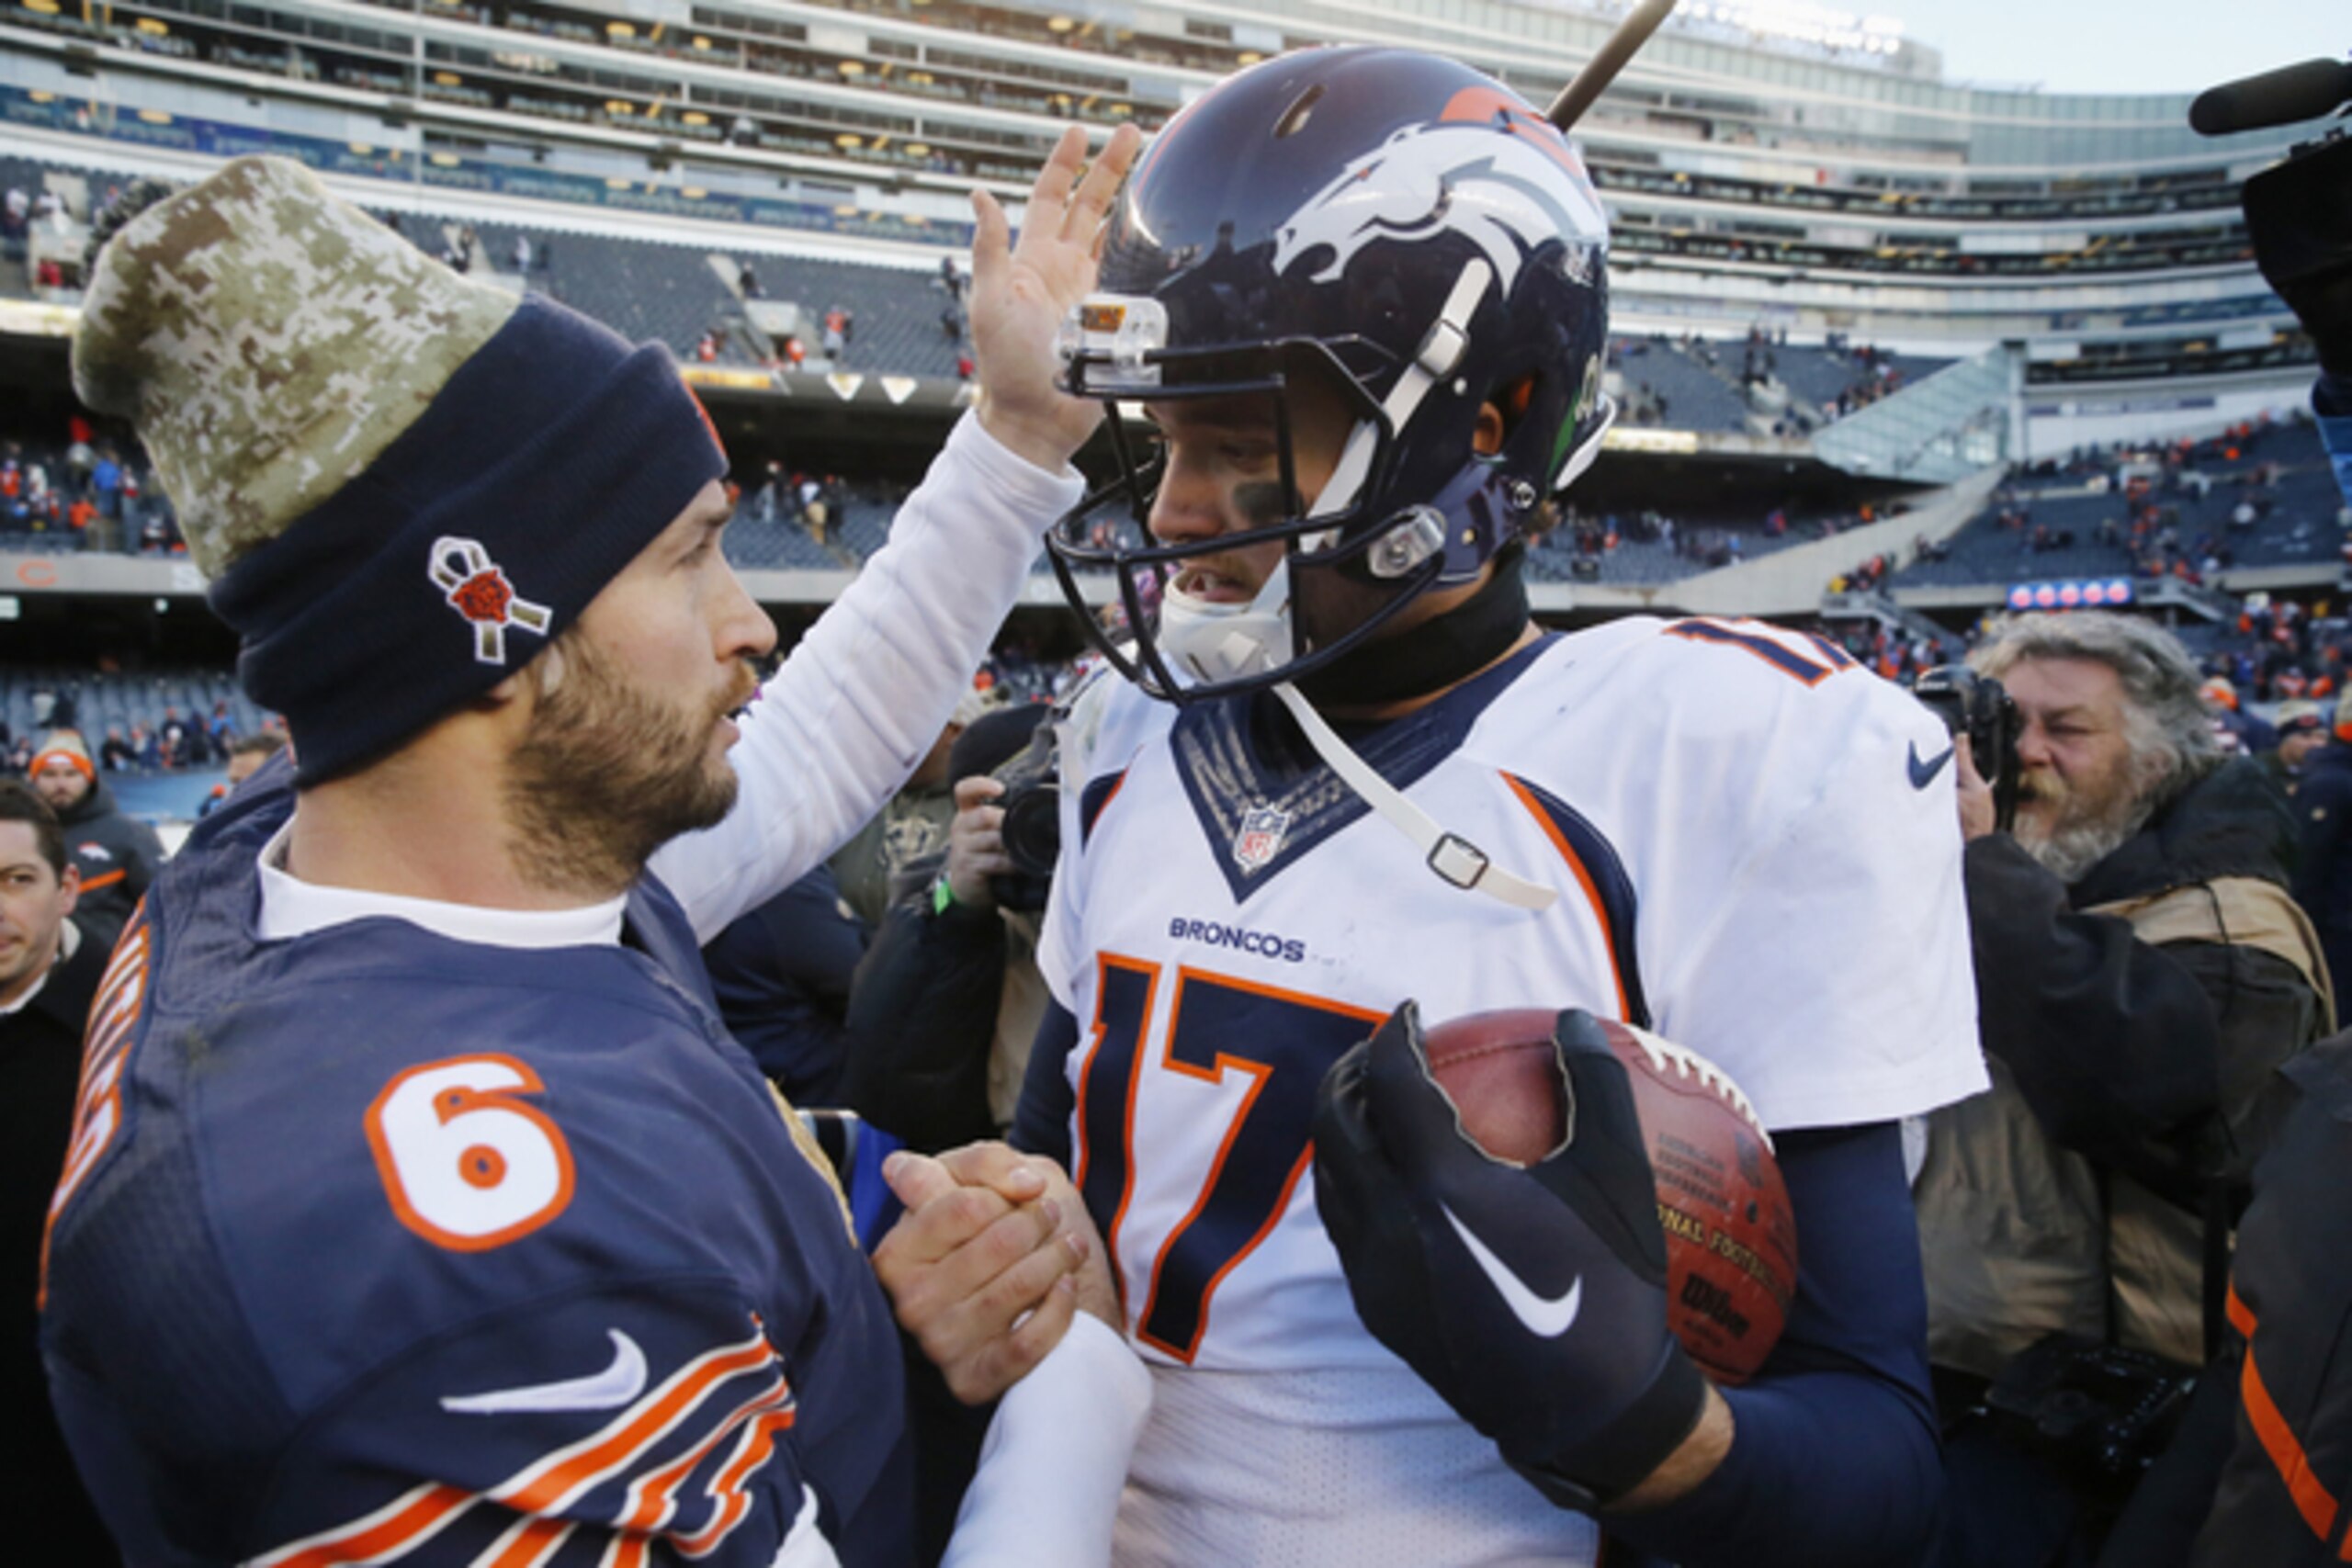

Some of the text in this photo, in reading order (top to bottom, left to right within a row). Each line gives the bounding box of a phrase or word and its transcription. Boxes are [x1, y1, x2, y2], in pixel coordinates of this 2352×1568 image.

[1169, 916, 1306, 964] BRONCOS
[362, 1051, 578, 1254] 6
[1072, 950, 1389, 1366] 17
